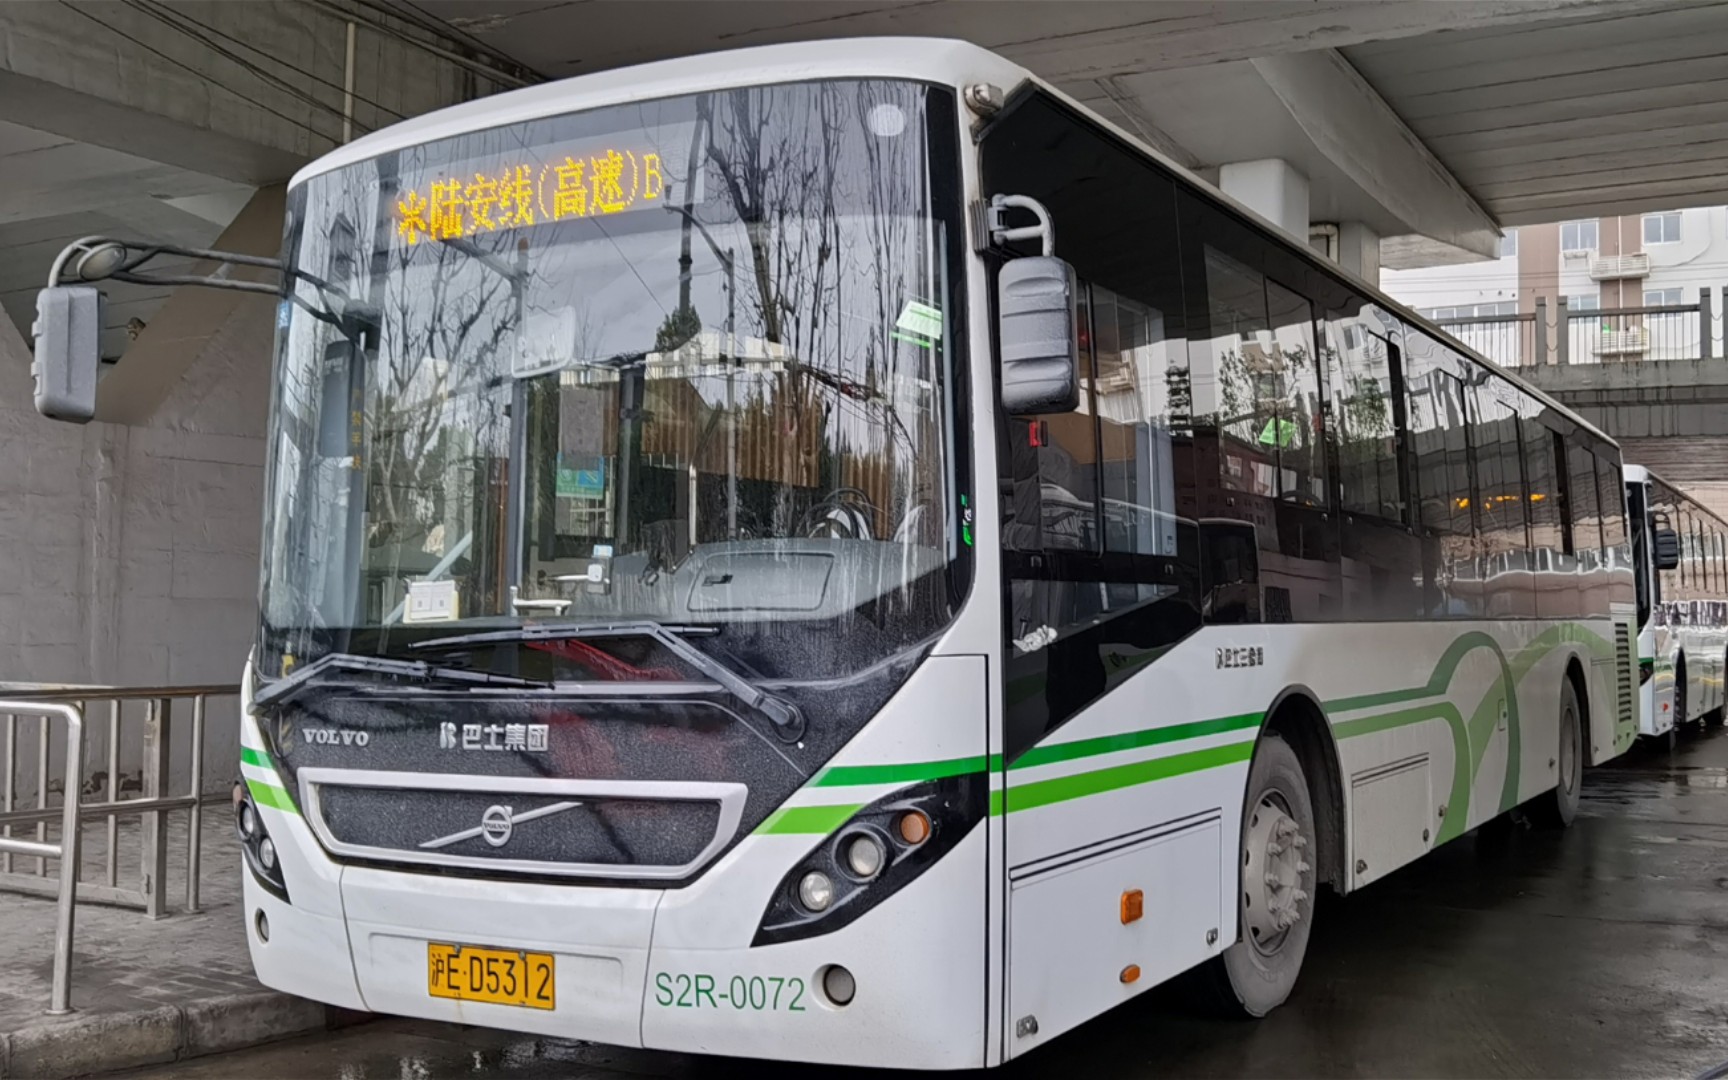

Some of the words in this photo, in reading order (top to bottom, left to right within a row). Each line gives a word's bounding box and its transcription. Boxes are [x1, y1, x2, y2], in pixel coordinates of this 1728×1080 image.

[302, 728, 369, 746] VOLVO
[462, 723, 549, 751] 巴士集团
[655, 972, 806, 1011] S2R-0072
